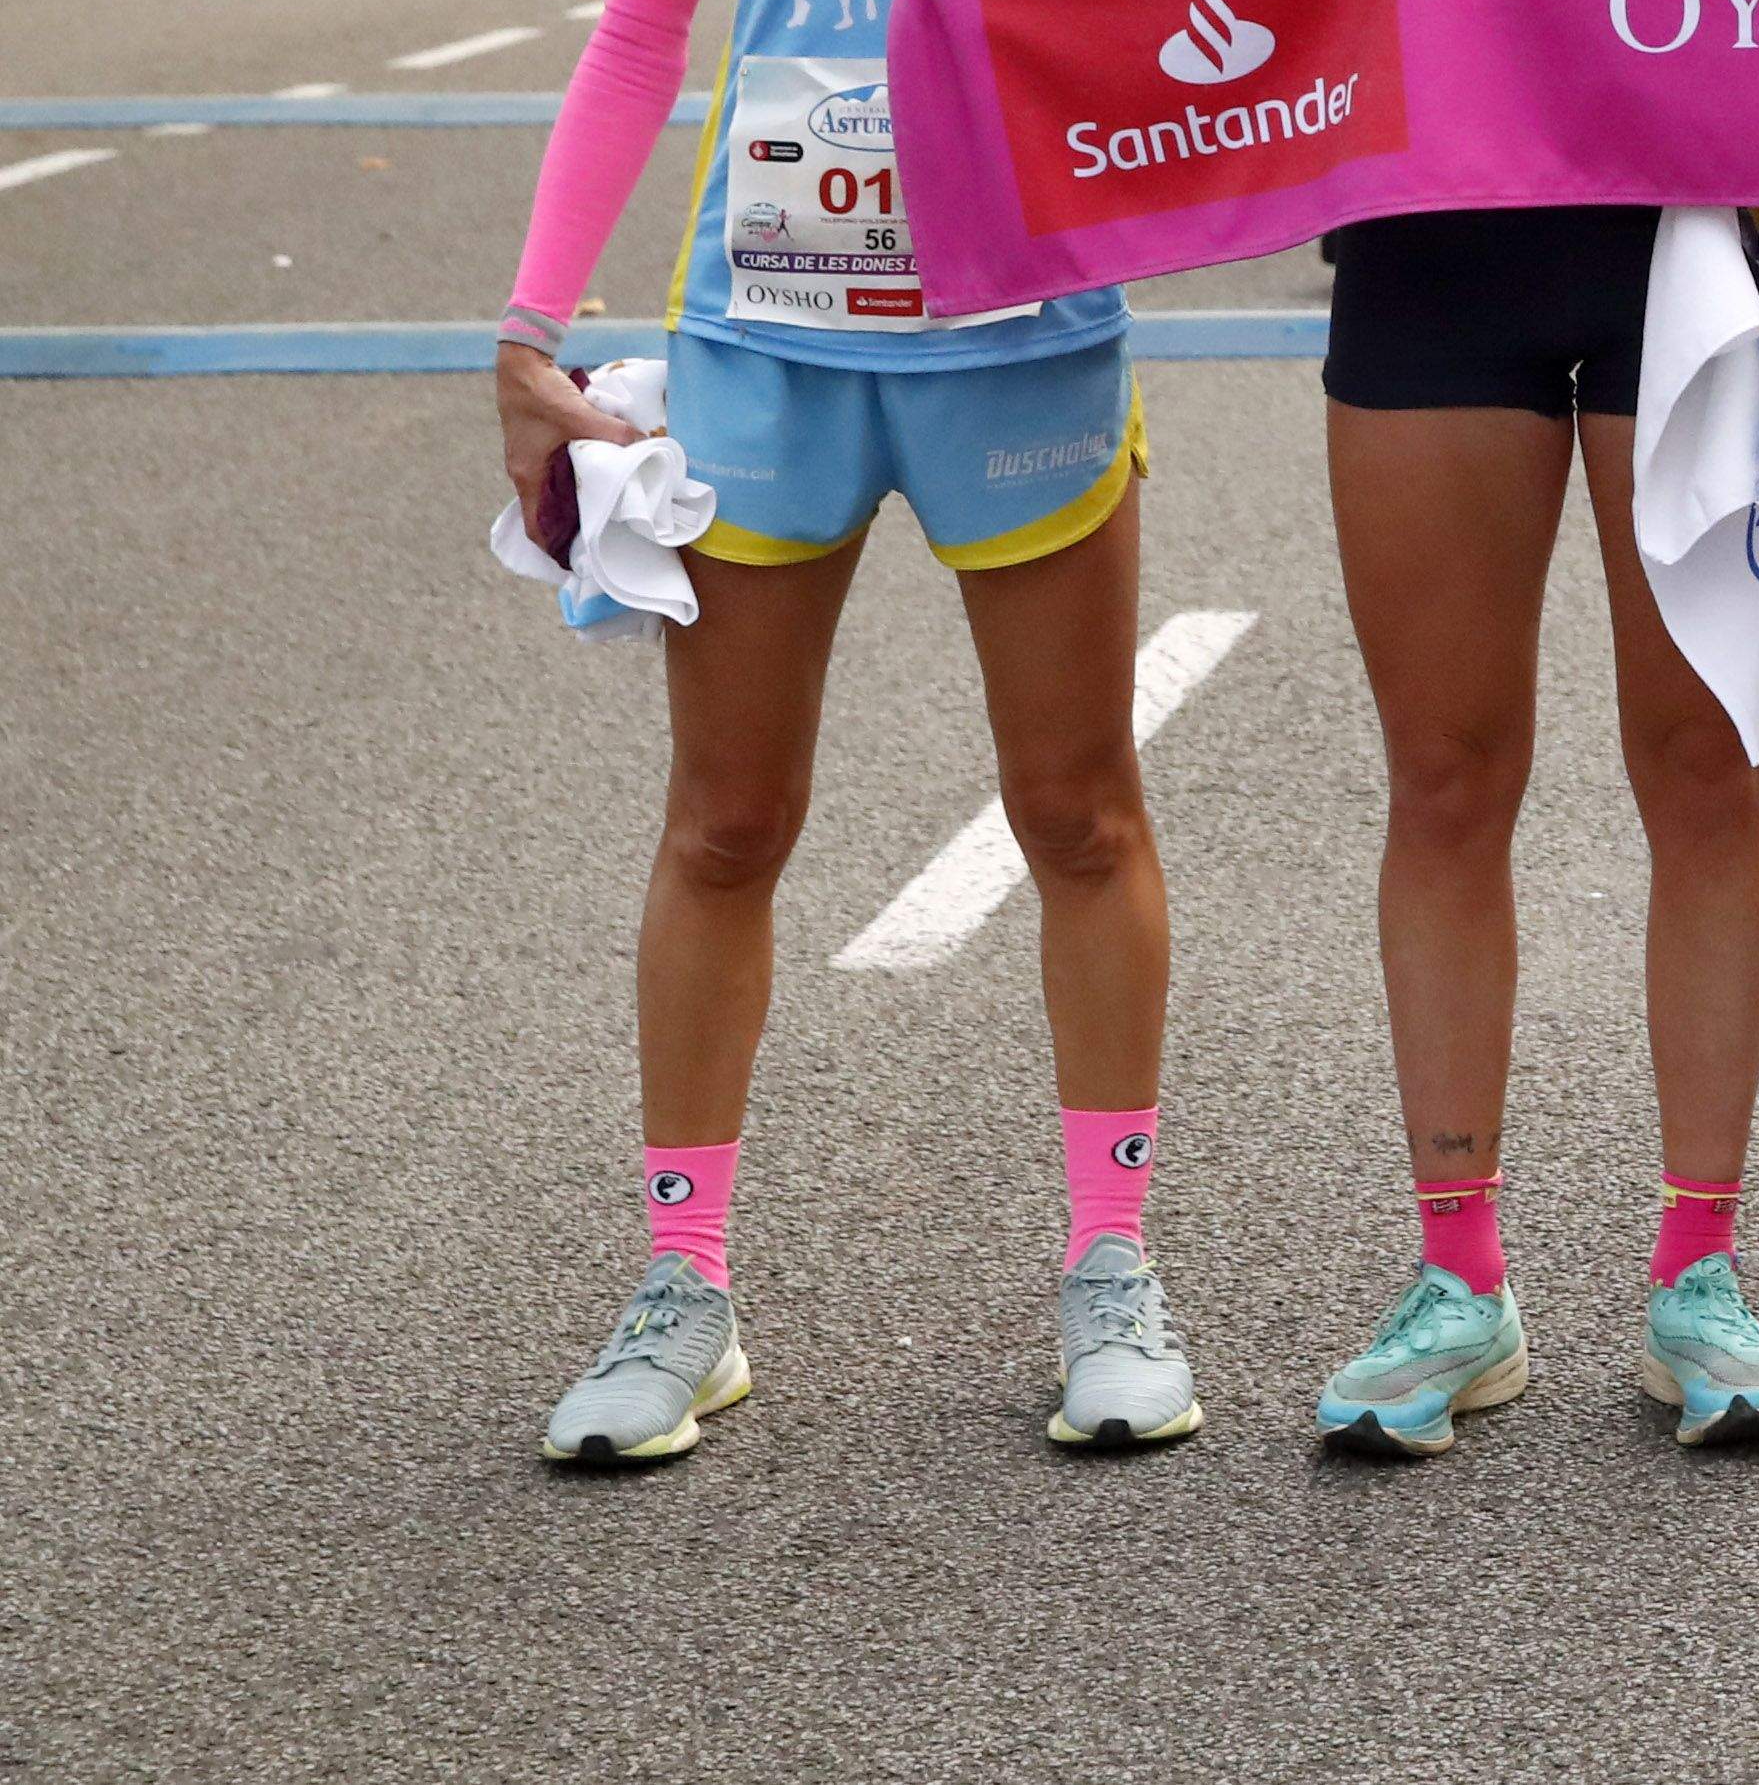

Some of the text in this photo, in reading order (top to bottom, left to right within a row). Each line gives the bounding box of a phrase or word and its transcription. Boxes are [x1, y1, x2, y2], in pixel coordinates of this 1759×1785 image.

[817, 107, 893, 134] ASTUR
[1066, 72, 1359, 179] Santander
[818, 167, 893, 215] 01
[864, 228, 897, 251] 56
[740, 252, 790, 269] CURSA
[793, 254, 815, 270] DE
[818, 255, 848, 271] LES
[851, 256, 906, 272] DONES
[746, 284, 834, 310] OYSHO
[868, 297, 913, 308] Santander
